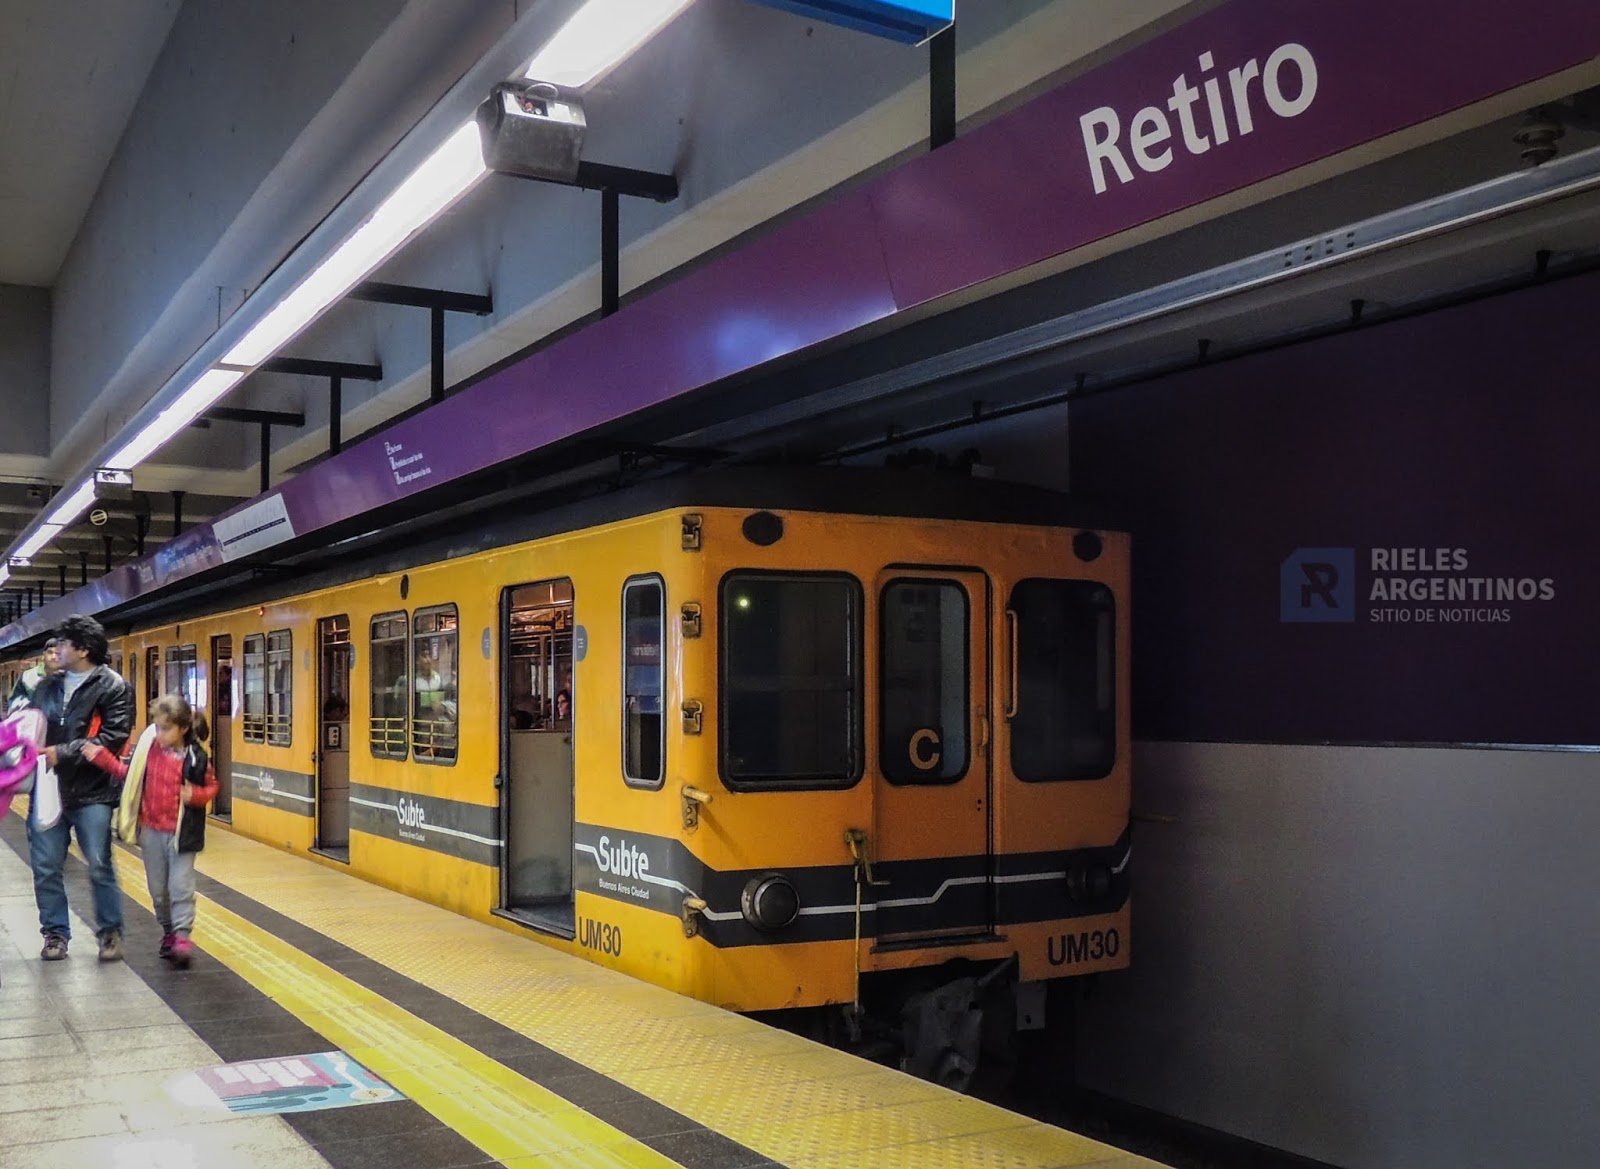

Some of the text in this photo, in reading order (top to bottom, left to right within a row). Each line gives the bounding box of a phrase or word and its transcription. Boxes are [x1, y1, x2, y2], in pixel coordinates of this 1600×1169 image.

[1079, 43, 1318, 195] Retiro
[909, 728, 941, 770] C
[398, 797, 425, 829] Subte
[597, 835, 649, 881] Subte
[578, 915, 622, 958] UM30
[1048, 927, 1120, 967] UM30
